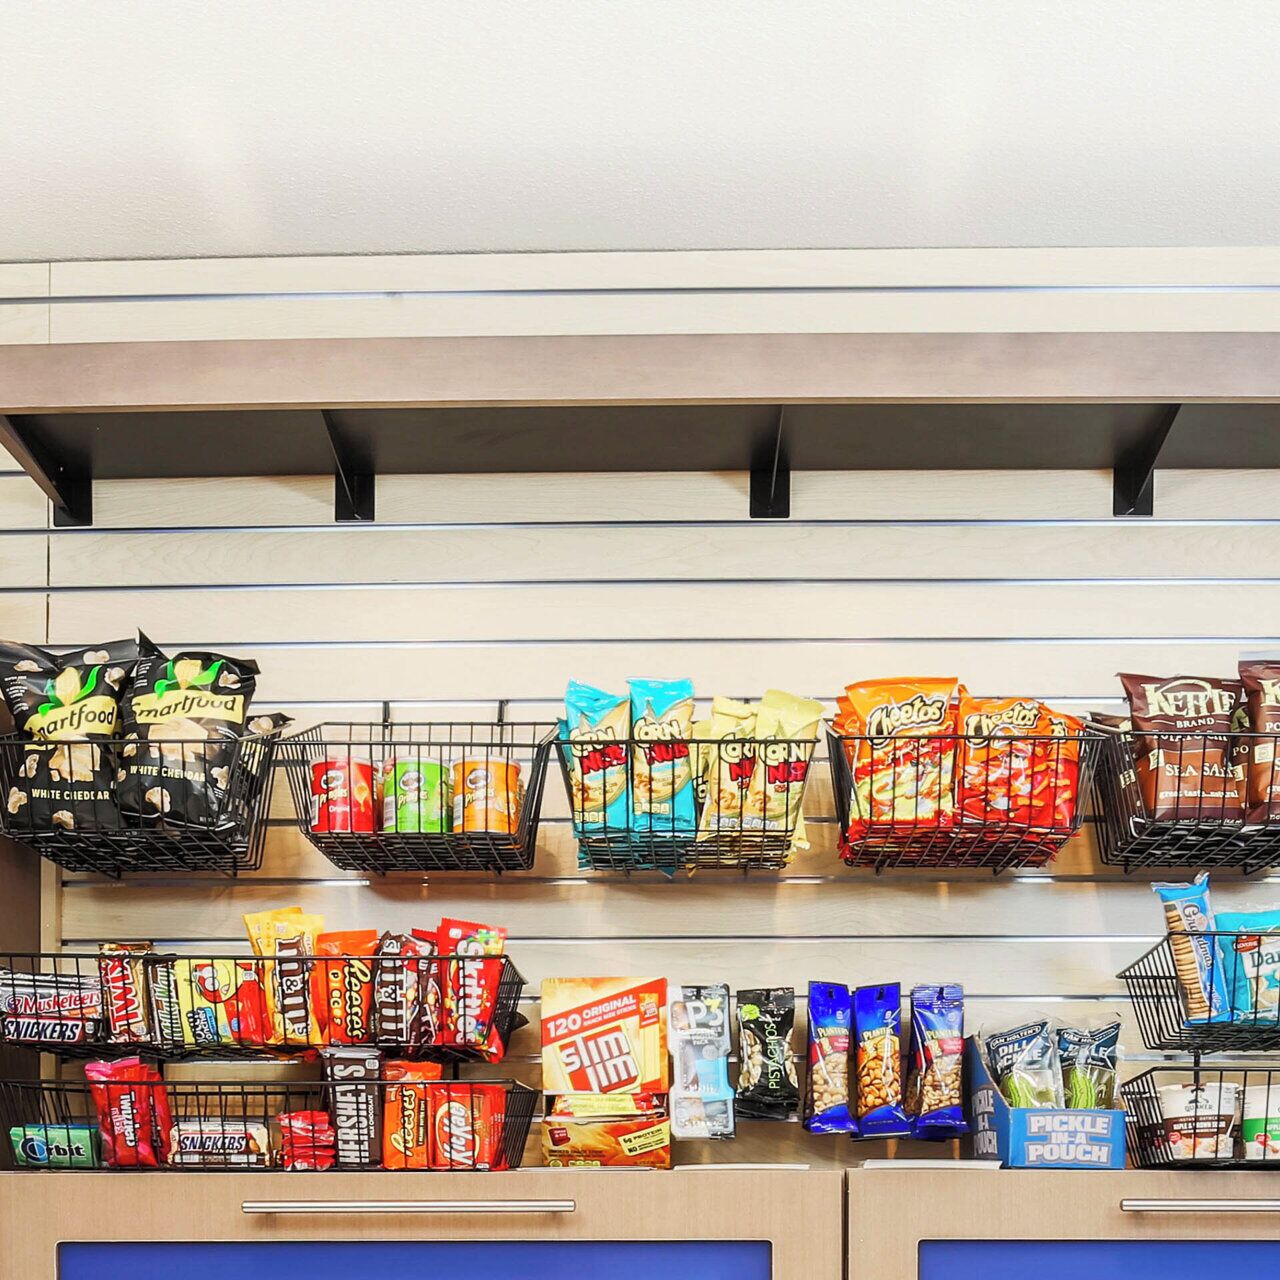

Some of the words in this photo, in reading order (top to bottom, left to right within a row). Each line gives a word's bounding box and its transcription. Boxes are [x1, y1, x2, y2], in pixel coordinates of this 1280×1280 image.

[866, 694, 946, 749] Cheetos
[965, 702, 1041, 748] Cheetos
[1176, 717, 1215, 728] BRAND
[1165, 762, 1198, 778] SEA
[31, 788, 61, 800] WHITE
[22, 989, 103, 1015] Musketeers
[546, 1013, 583, 1039] 120
[582, 993, 637, 1019] ORIGINAL
[5, 1020, 83, 1043] SNICKERS
[999, 1040, 1028, 1058] DILL
[1030, 1115, 1108, 1134] PICKLE
[181, 1135, 247, 1153] SNICKERS
[1051, 1132, 1087, 1145] IN-A
[1027, 1144, 1108, 1162] POUCH
